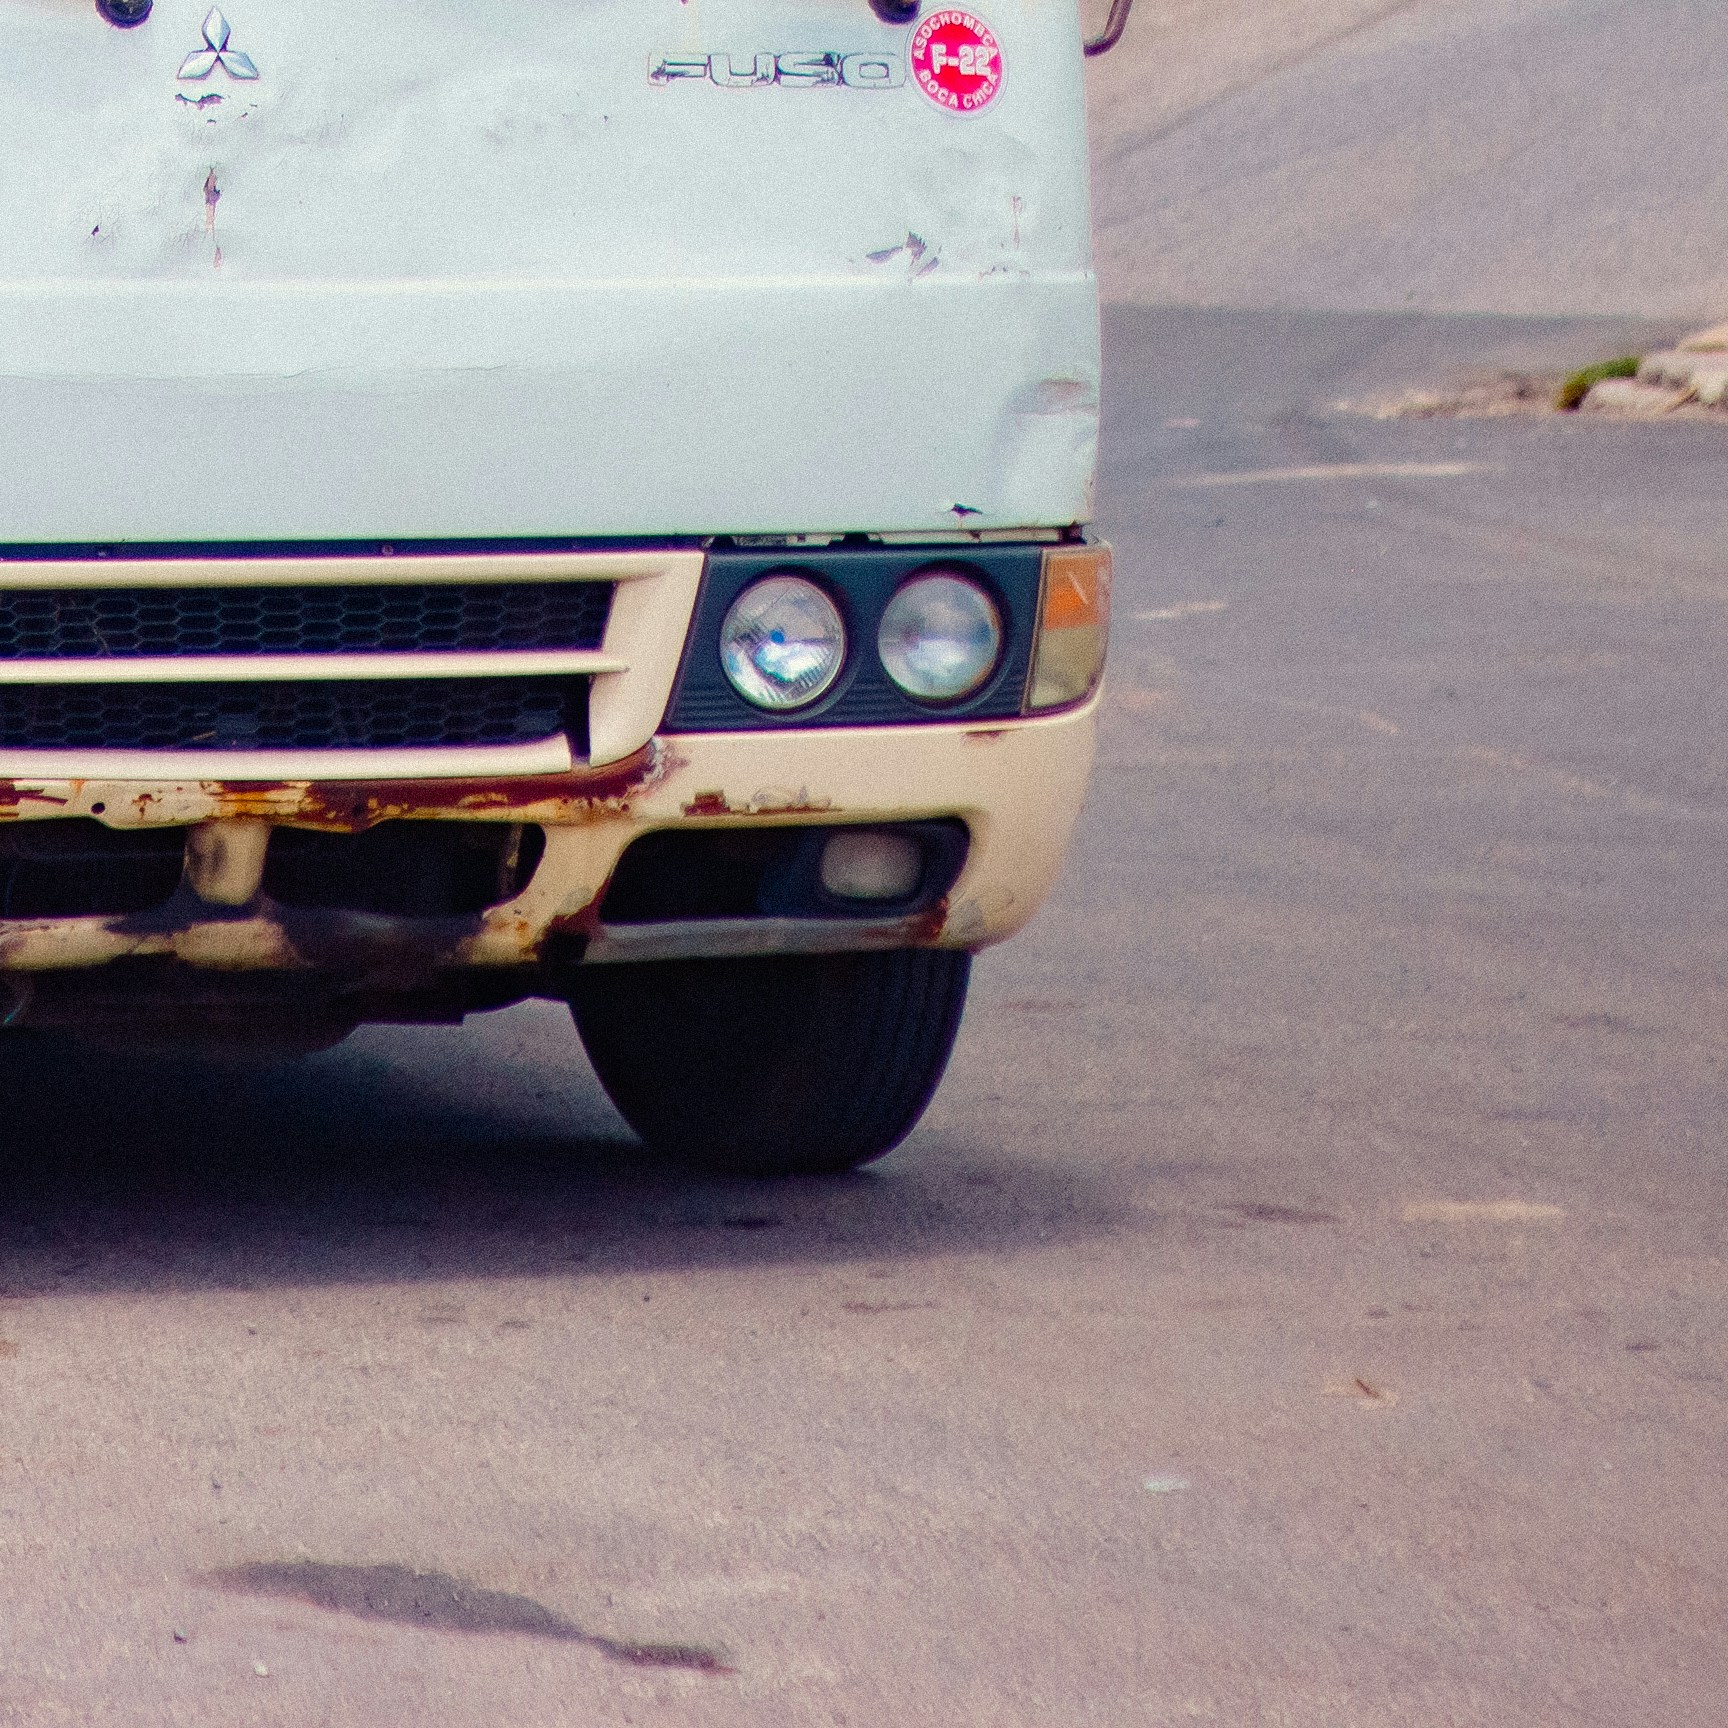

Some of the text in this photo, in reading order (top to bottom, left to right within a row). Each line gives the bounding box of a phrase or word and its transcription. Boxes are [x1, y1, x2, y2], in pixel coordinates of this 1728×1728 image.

[647, 51, 908, 89] FUSO
[930, 43, 993, 76] F-22
[918, 69, 999, 109] BOCA CHICA
